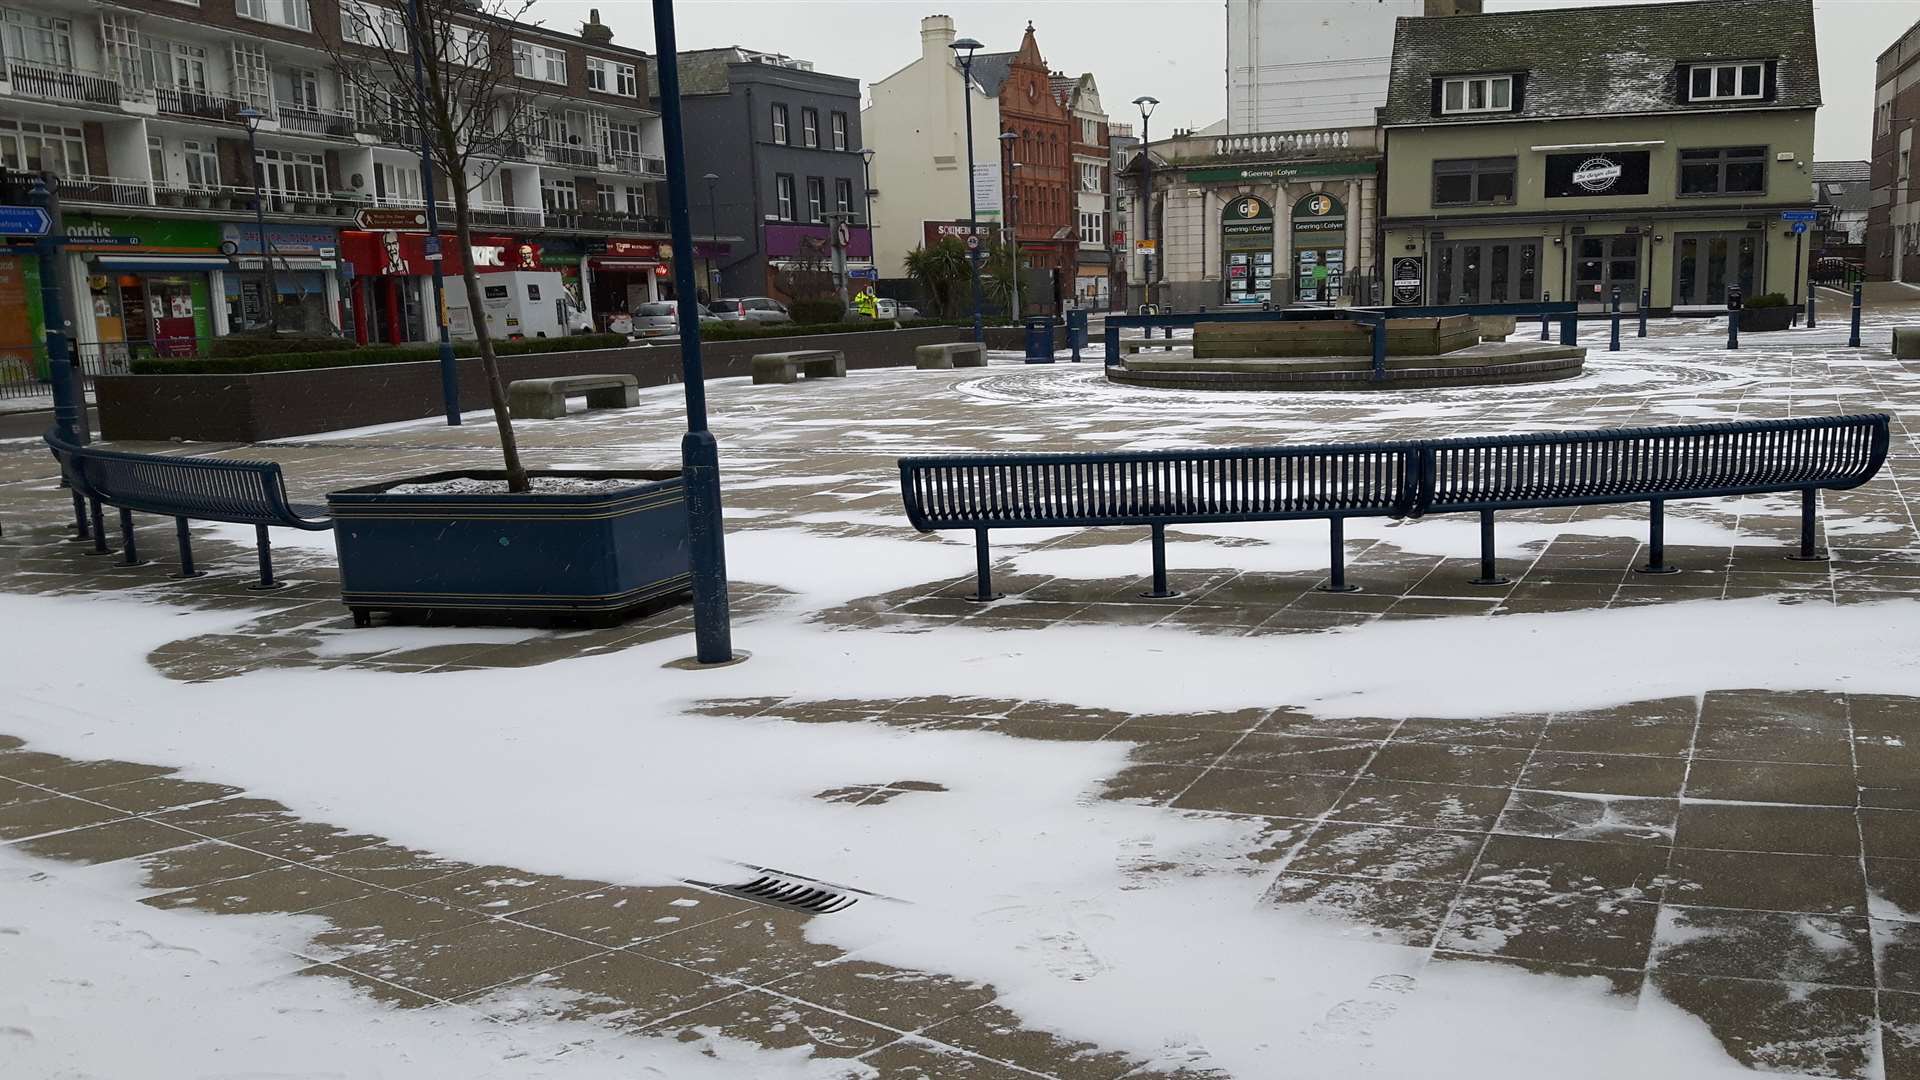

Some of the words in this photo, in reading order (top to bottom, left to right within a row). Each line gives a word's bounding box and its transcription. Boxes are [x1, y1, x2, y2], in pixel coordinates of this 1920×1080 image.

[1225, 225, 1249, 233] Geering
[1296, 222, 1319, 230] Geering
[1324, 221, 1343, 229] Colyer
